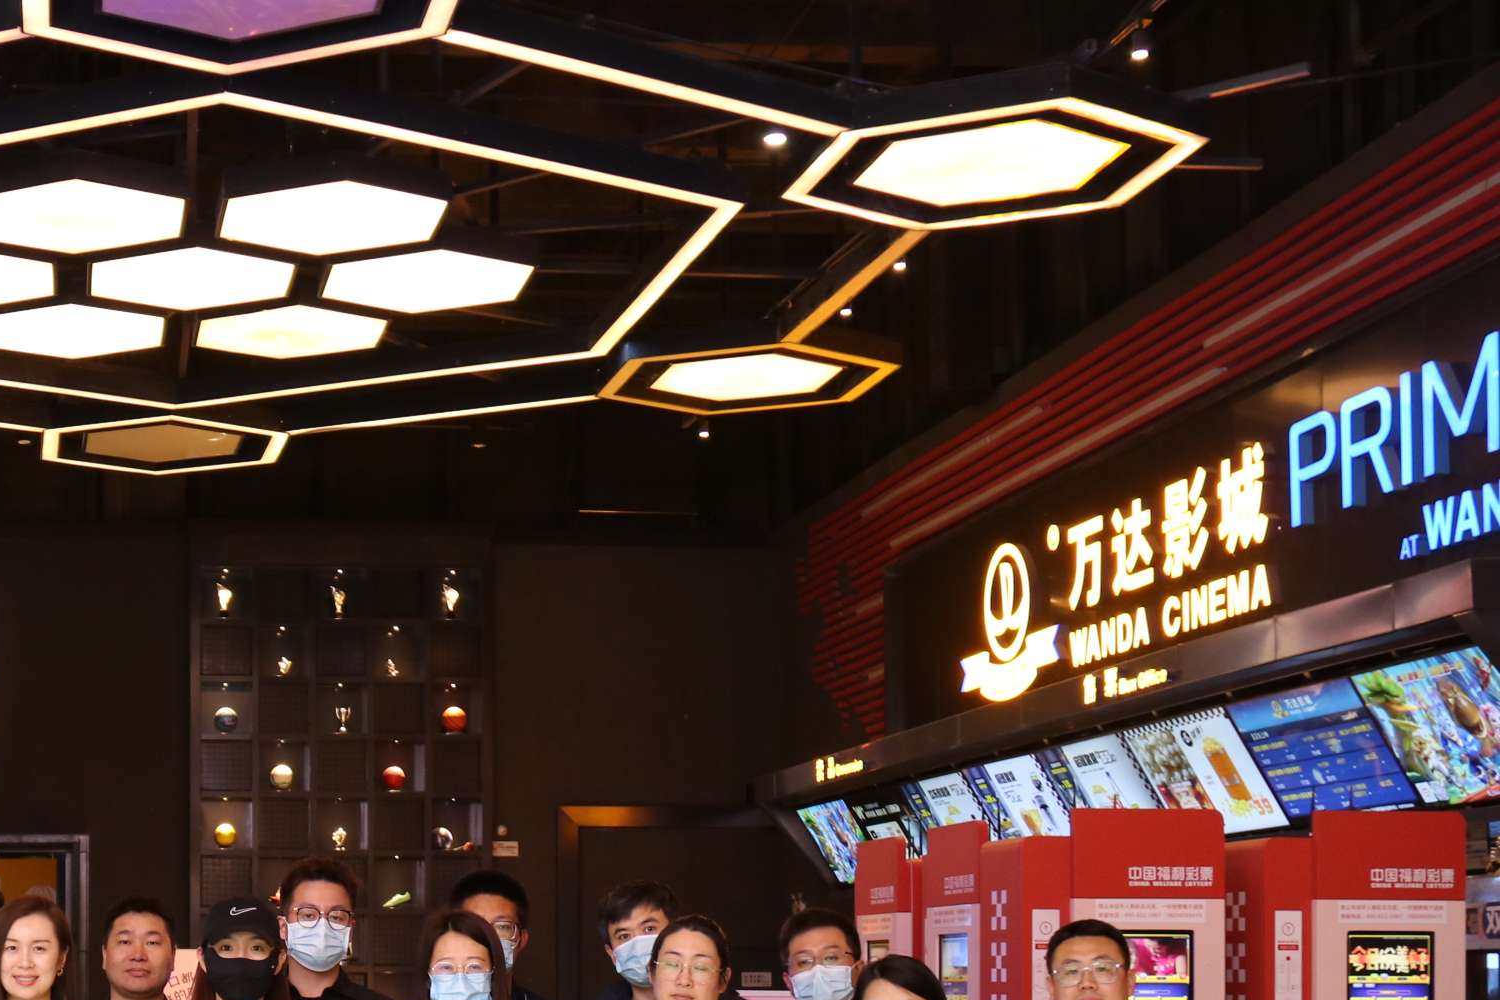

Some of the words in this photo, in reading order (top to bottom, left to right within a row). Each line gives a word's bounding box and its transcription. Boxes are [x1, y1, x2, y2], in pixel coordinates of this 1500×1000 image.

[1066, 441, 1269, 613] 万达影城
[1399, 533, 1419, 561] AT
[1068, 606, 1151, 668] WANDA
[1161, 563, 1272, 639] CINEMA
[1128, 866, 1213, 881] 中国福利彩票
[1370, 868, 1455, 883] 中国福利彩票
